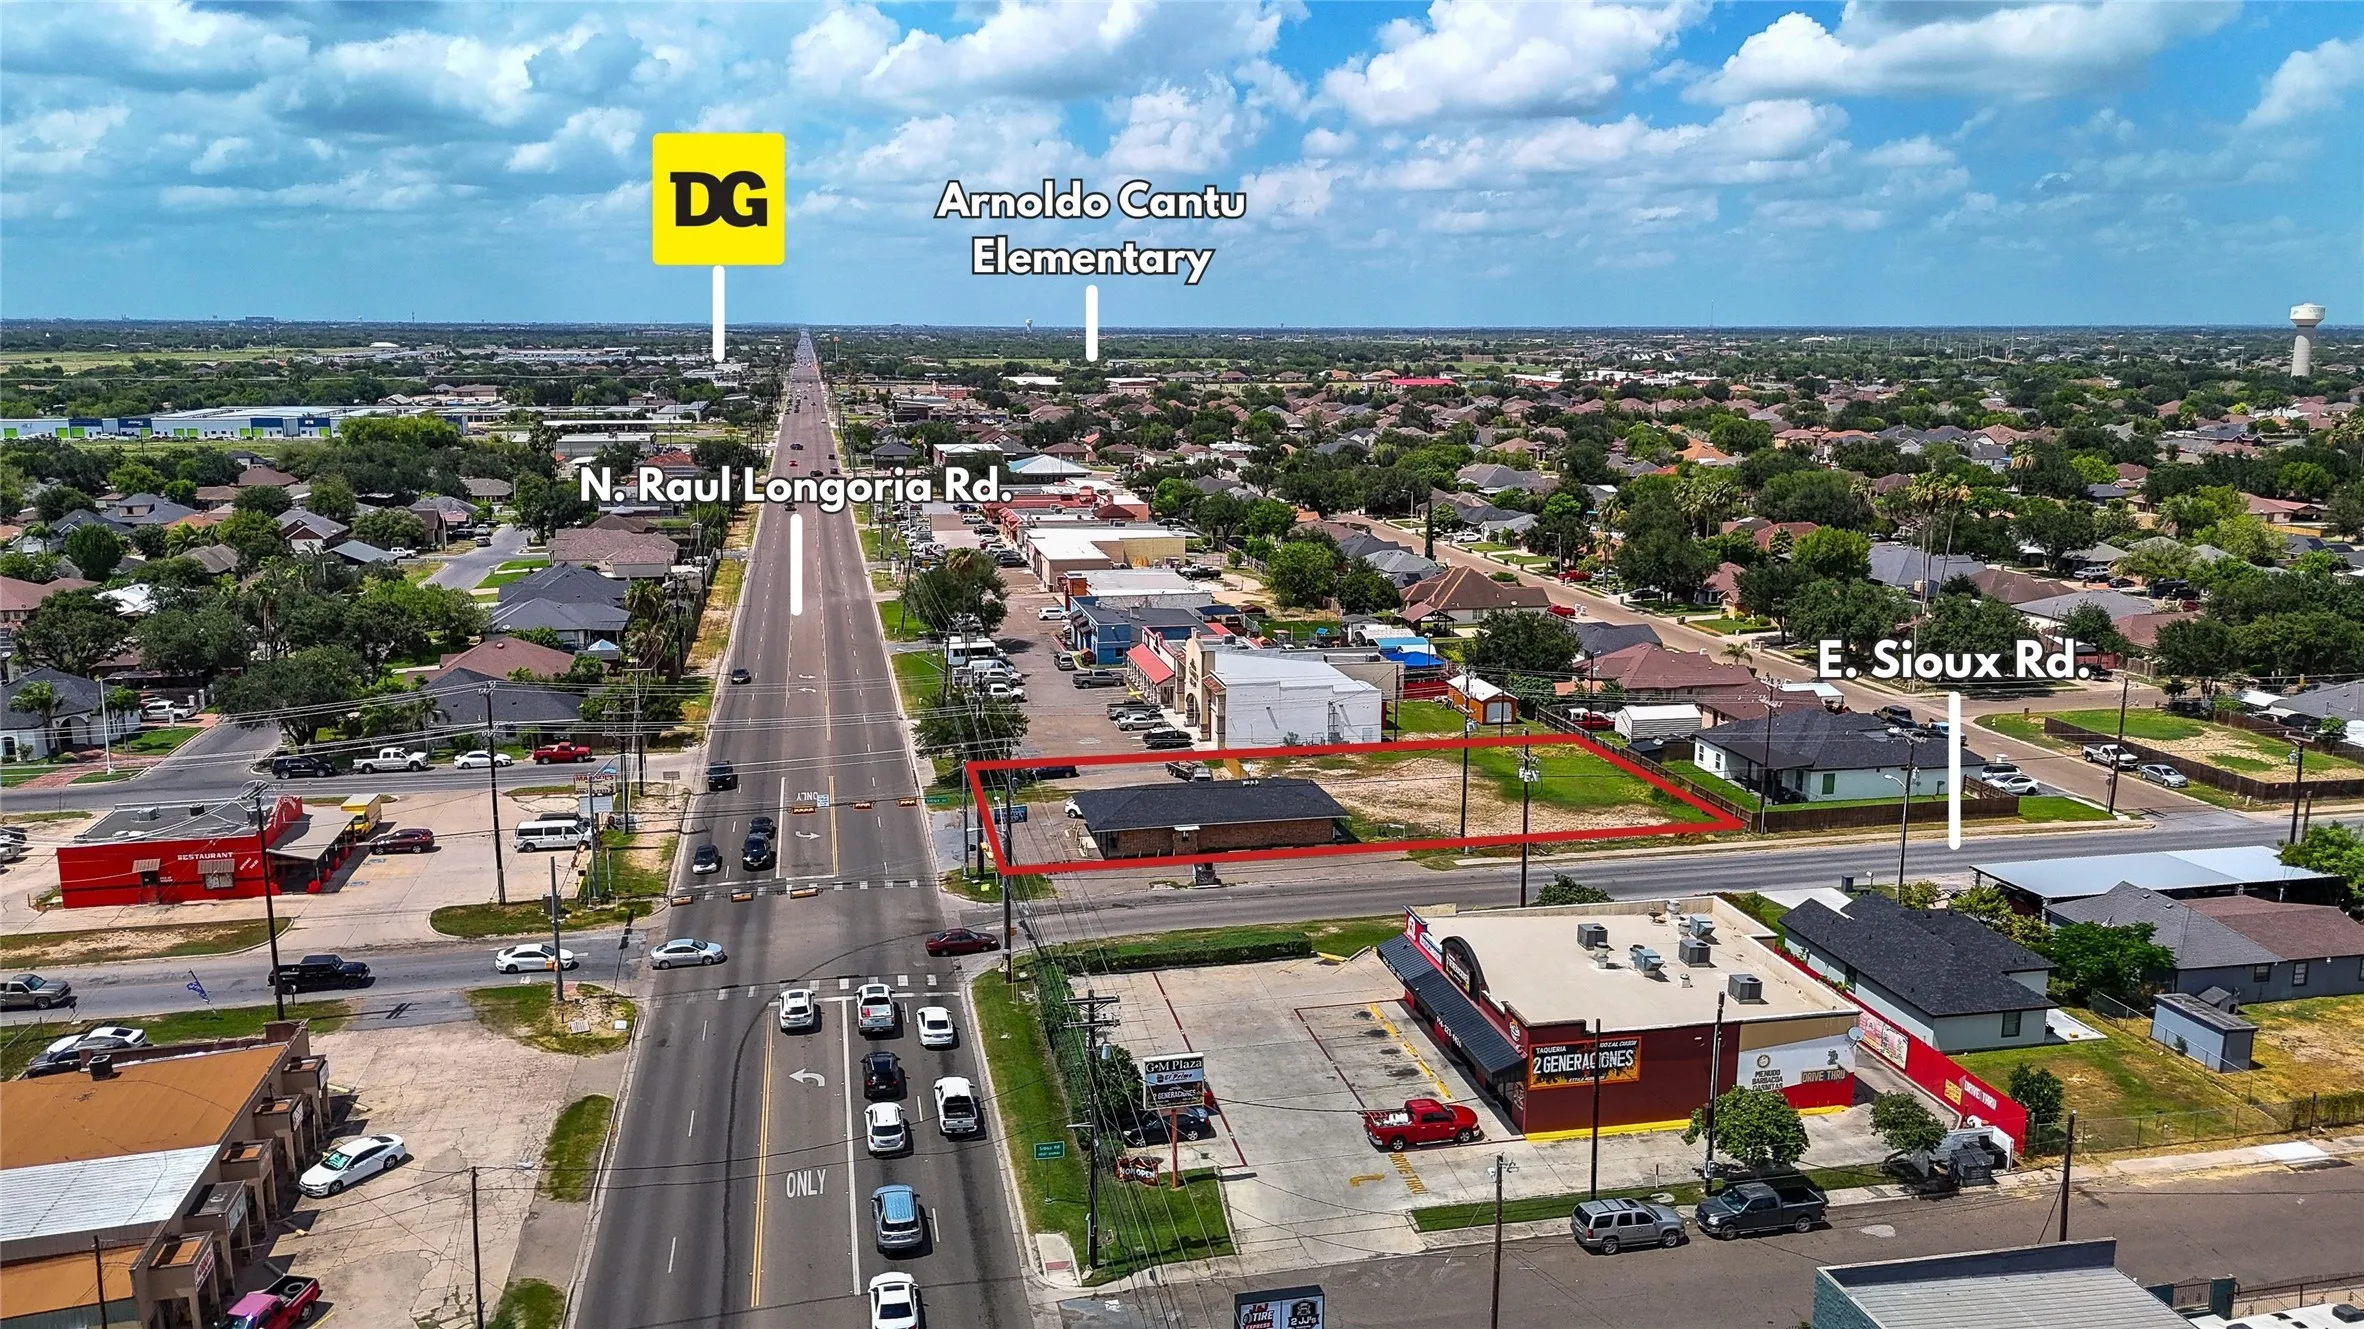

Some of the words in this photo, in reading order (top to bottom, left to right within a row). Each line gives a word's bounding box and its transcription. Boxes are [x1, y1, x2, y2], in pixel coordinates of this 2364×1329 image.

[796, 791, 819, 801] ONLY
[177, 852, 234, 861] RESTAURANT
[1535, 1045, 1567, 1055] TAQUERIA
[1172, 1059, 1202, 1070] Plaza
[1533, 1056, 1542, 1074] 2
[1543, 1049, 1634, 1074] GENERACIONES
[1754, 1069, 1781, 1078] MENUDO
[1802, 1070, 1824, 1083] DRIVE
[1827, 1069, 1846, 1080] THRU
[1965, 1080, 1980, 1099] DRIVE
[1136, 1168, 1156, 1179] OPEN
[786, 1168, 827, 1198] ONLY
[1252, 1310, 1274, 1322] TIRE
[1290, 1317, 1298, 1326] 2
